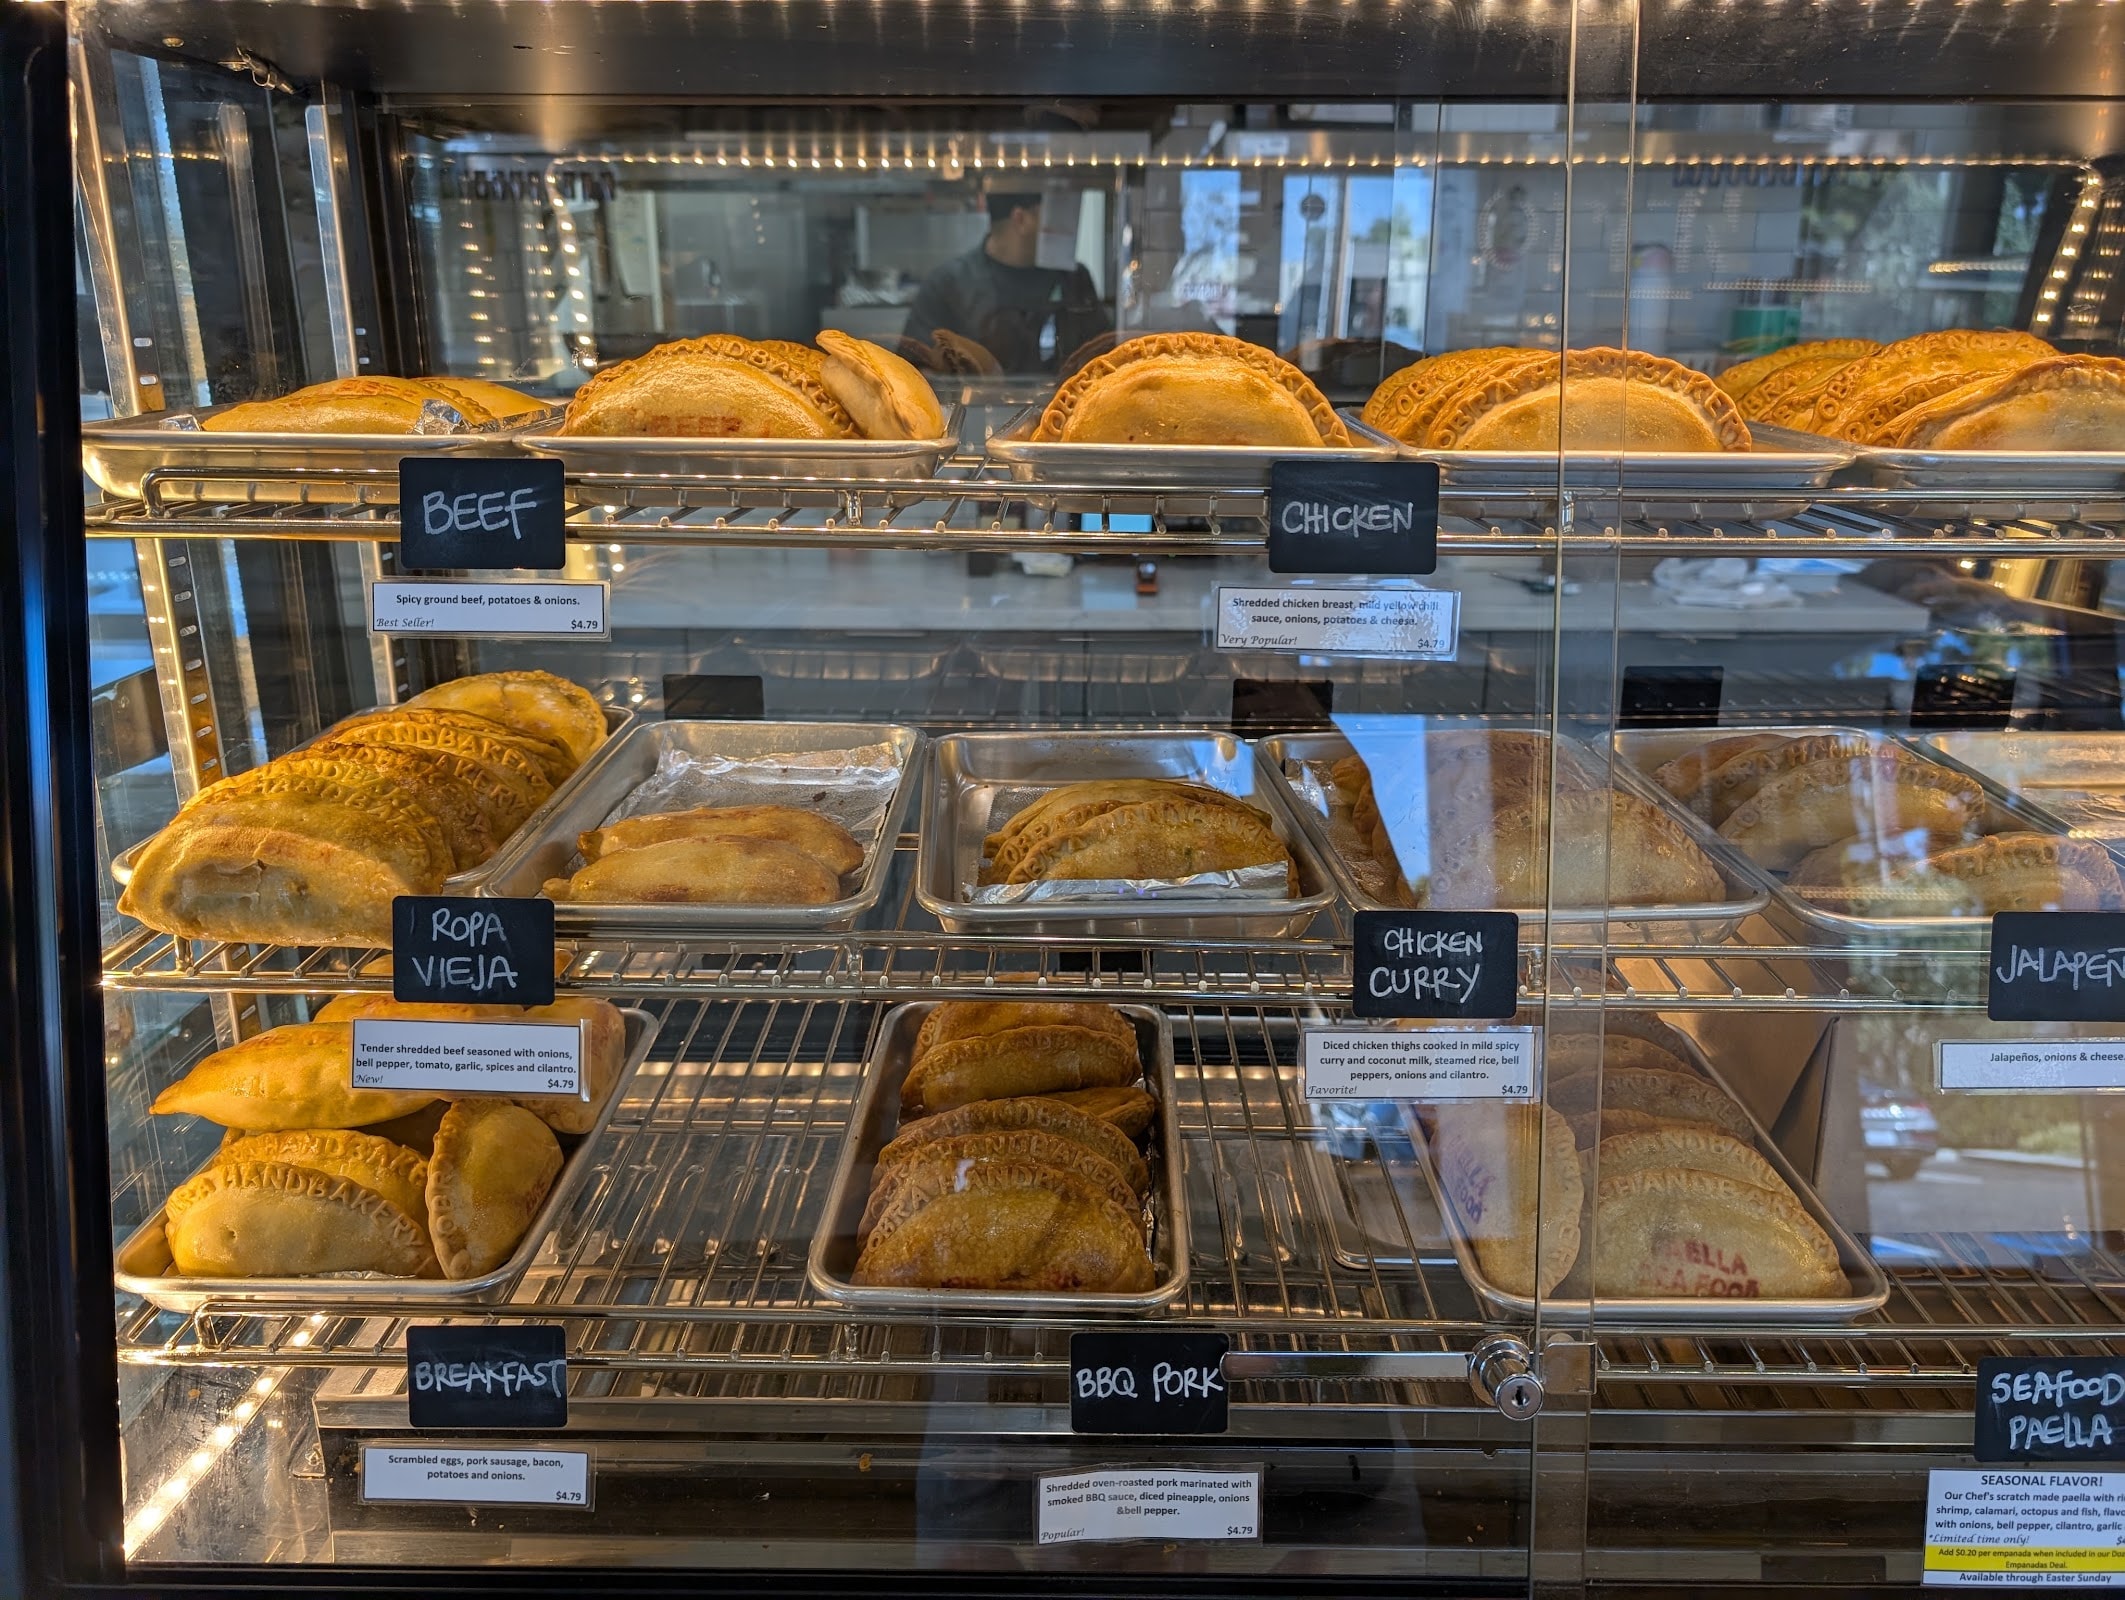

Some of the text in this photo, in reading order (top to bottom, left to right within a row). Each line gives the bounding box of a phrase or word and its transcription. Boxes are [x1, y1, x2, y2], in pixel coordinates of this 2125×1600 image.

[422, 487, 537, 540] BEEF
[1282, 502, 1413, 538] CHICKEN
[396, 594, 580, 607] Spicy ground beef, potatoes & onions.
[1233, 598, 1280, 608] Shredded
[1282, 599, 1319, 609] chicken
[1322, 599, 1356, 610] breast,
[376, 618, 435, 628] Best Seller!
[571, 619, 598, 630] $4.79
[1251, 615, 1418, 626] sauce, onions, potatoes & cheese.
[1220, 633, 1297, 646] Very Popular!
[1417, 639, 1445, 650] $4.79
[432, 908, 507, 947] ROPA
[1384, 927, 1483, 958] CHICKEN
[412, 955, 518, 990] VIEJA
[1369, 963, 1481, 1004] CURRY
[361, 1044, 572, 1060] Tender shredded beef seasoned with onions,
[1323, 1041, 1519, 1053] Diced chicken thighs cooked in mild spicy
[1320, 1056, 1519, 1067] curry and coconut milk, steamed rice, bell
[1990, 1052, 2041, 1063] Jalapeños,
[2044, 1053, 2077, 1061] onions
[2079, 1053, 2087, 1061] &
[356, 1058, 576, 1074] bell pepper, tomato, garlic, spices and cilantro.
[355, 1074, 384, 1084] New!
[1350, 1070, 1489, 1082] peppers, onions and cilantro.
[548, 1079, 574, 1089] $4.79
[1501, 1085, 1528, 1095] $4.79
[1309, 1086, 1357, 1096] Favorite!
[415, 1359, 567, 1398] BREAKFAST
[1076, 1361, 1224, 1402] BBQ PORK
[1991, 1370, 2125, 1407] SEAFOOD
[2009, 1412, 2112, 1450] PAELLA
[388, 1455, 563, 1468] Scrambled eggs, pork sausage, bacon,
[427, 1470, 525, 1480] potatoes and onions.
[1981, 1475, 2102, 1486] SEASONAL FLAVOR!
[1046, 1478, 1252, 1493] Shredded oven-roasted pork marinated with
[556, 1491, 581, 1501] $4.79
[1047, 1492, 1250, 1506] smoked BBQ sauce, diced pineapple, onions
[1945, 1492, 1963, 1501] Our
[1965, 1492, 1995, 1501] Chef's
[1997, 1493, 2031, 1502] scratch
[2033, 1493, 2060, 1502] made
[2062, 1493, 2090, 1503] paella
[2093, 1493, 2115, 1502] with
[1117, 1506, 1180, 1517] &bell pepper.
[1936, 1505, 1972, 1516] shrimp,
[1975, 1506, 2018, 1516] calamari,
[2021, 1507, 2058, 1517] octopus
[2061, 1507, 2079, 1516] and
[2081, 1507, 2101, 1517] fish,
[1227, 1526, 1253, 1535] $4.79
[1935, 1520, 2122, 1532] with onions, bell pepper, cilantro, garlic
[1041, 1528, 1085, 1542] Popular!
[1977, 1535, 2000, 1544] time
[2004, 1534, 2030, 1546] only!
[1956, 1549, 1976, 1557] $0.20
[1979, 1550, 1991, 1558] per
[1993, 1550, 2031, 1559] empanada
[2006, 1562, 2048, 1570] Empanadas
[1959, 1573, 2111, 1584] Available through Easter Sunday
